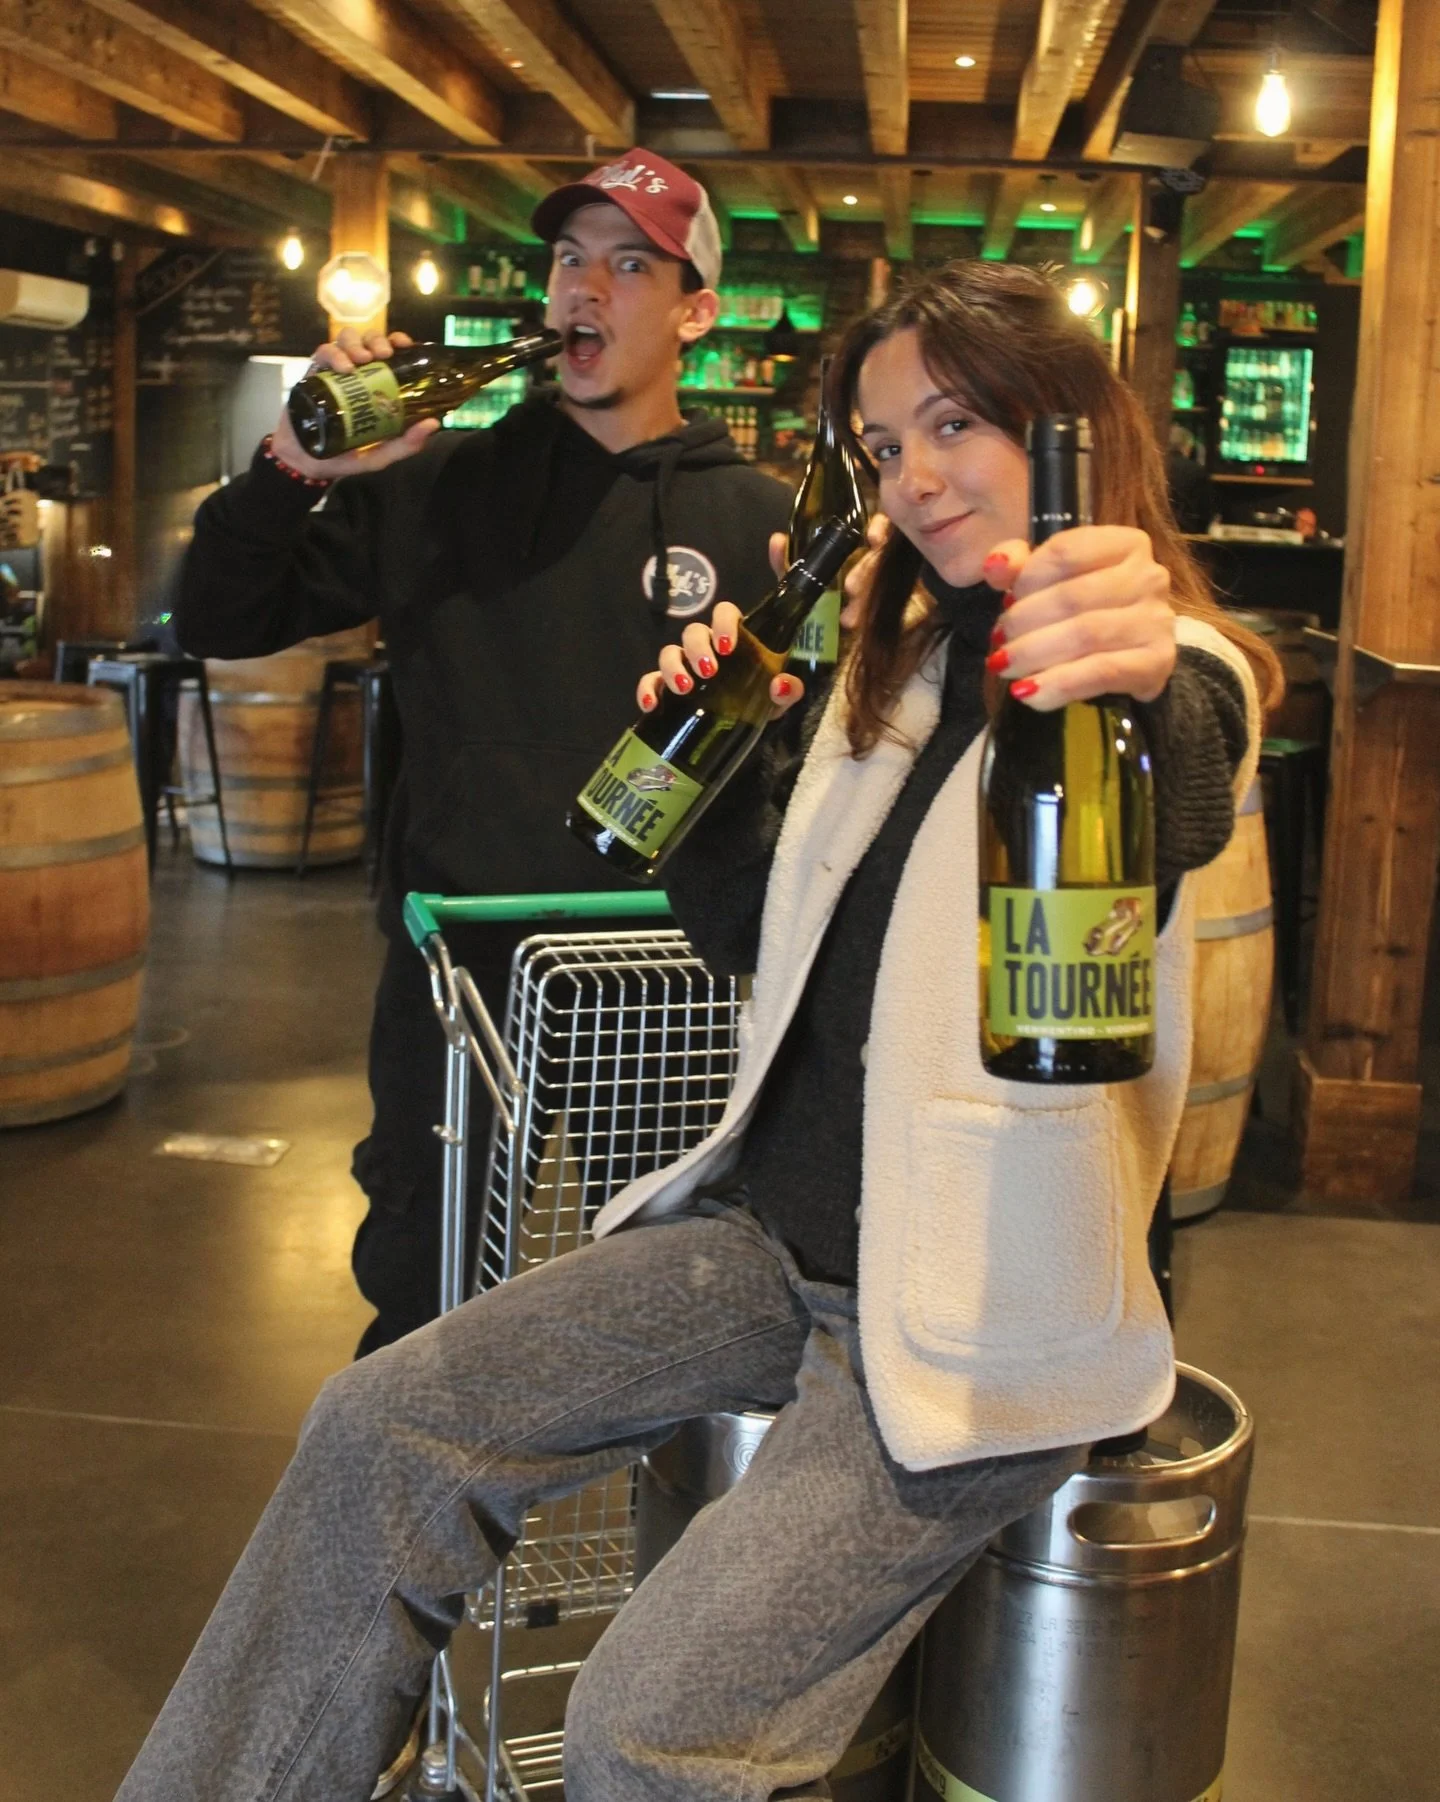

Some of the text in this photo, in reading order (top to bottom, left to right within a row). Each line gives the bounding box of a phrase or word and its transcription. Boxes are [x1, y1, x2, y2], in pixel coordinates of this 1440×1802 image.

[334, 372, 378, 437] OURNÉE
[587, 767, 665, 842] OURNÉE
[1005, 897, 1051, 956] LA
[1004, 951, 1152, 1020] TOURNÉE
